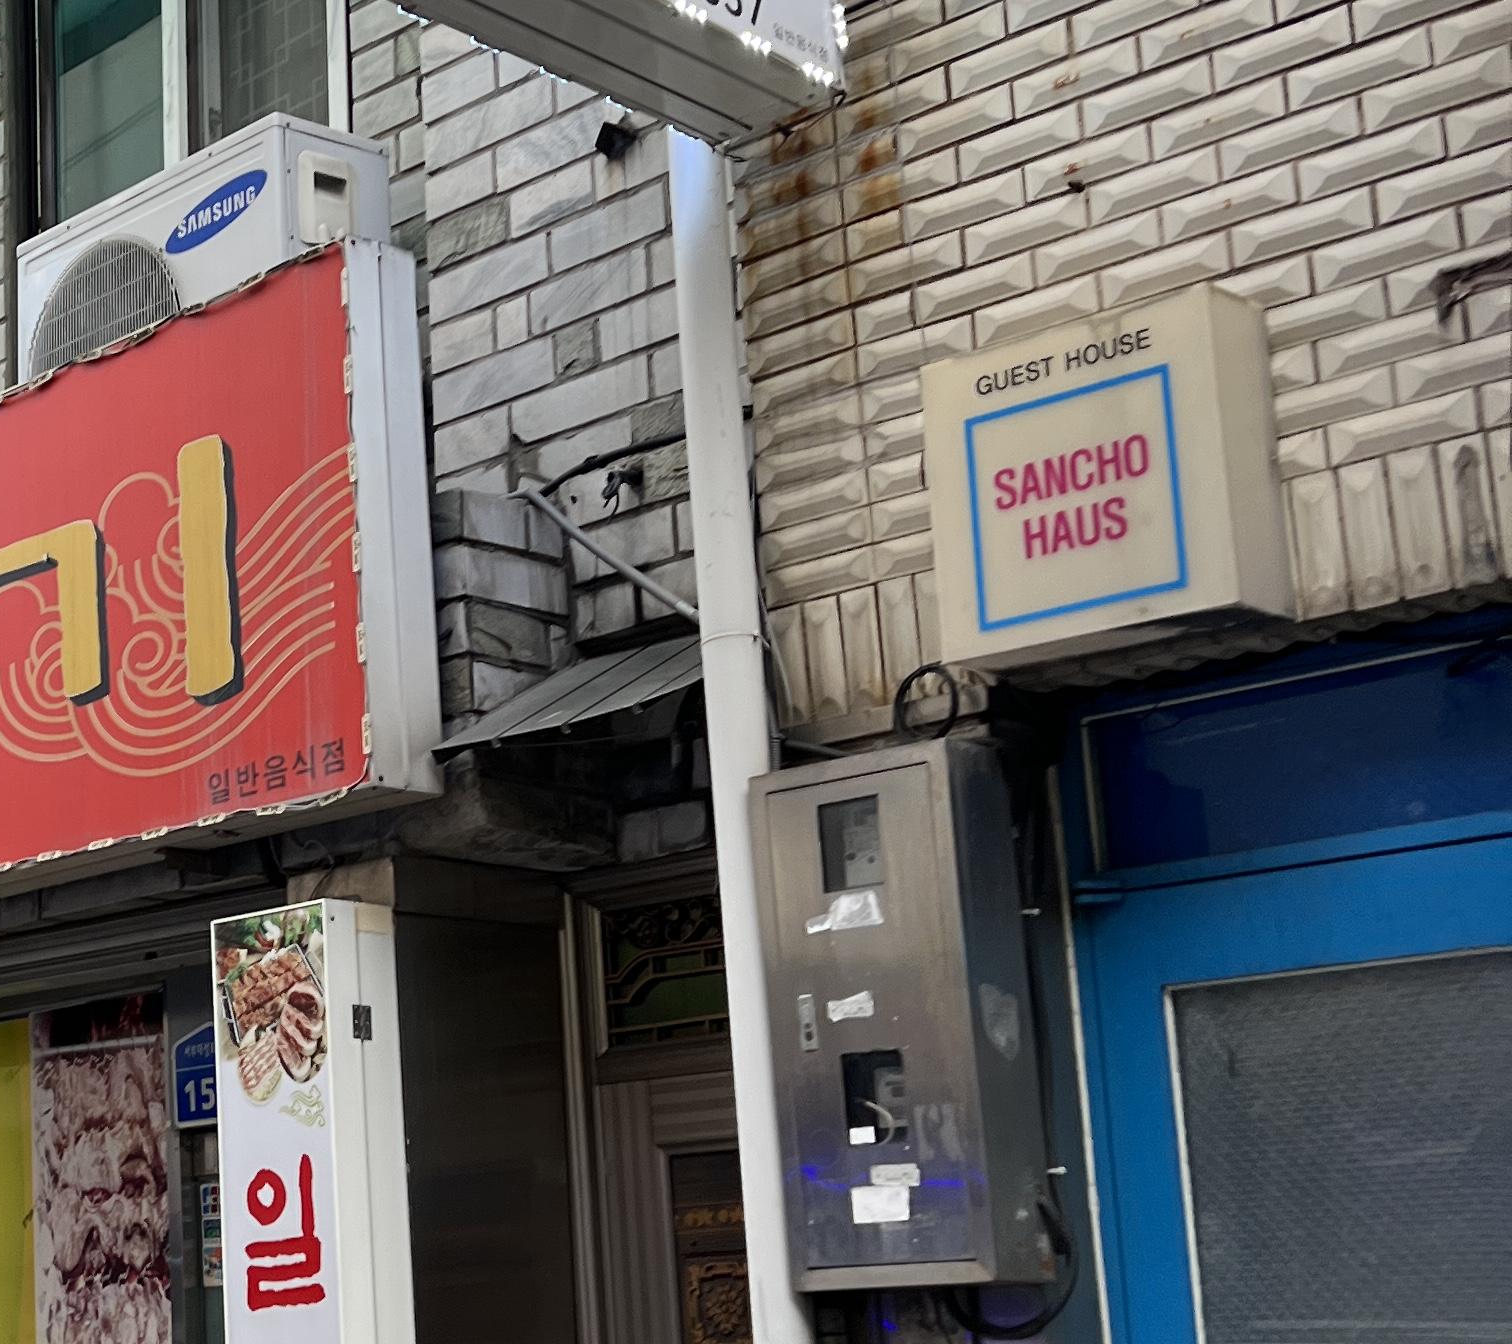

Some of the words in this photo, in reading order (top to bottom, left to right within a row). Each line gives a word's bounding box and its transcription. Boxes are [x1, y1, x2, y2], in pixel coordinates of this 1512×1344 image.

[176, 184, 257, 239] SAMSUNG
[976, 355, 1055, 397] GUEST
[1065, 327, 1153, 373] HOUSE
[993, 433, 1150, 511] SANCHO
[1023, 496, 1128, 559] HAUS
[208, 737, 345, 805] 일반음식점
